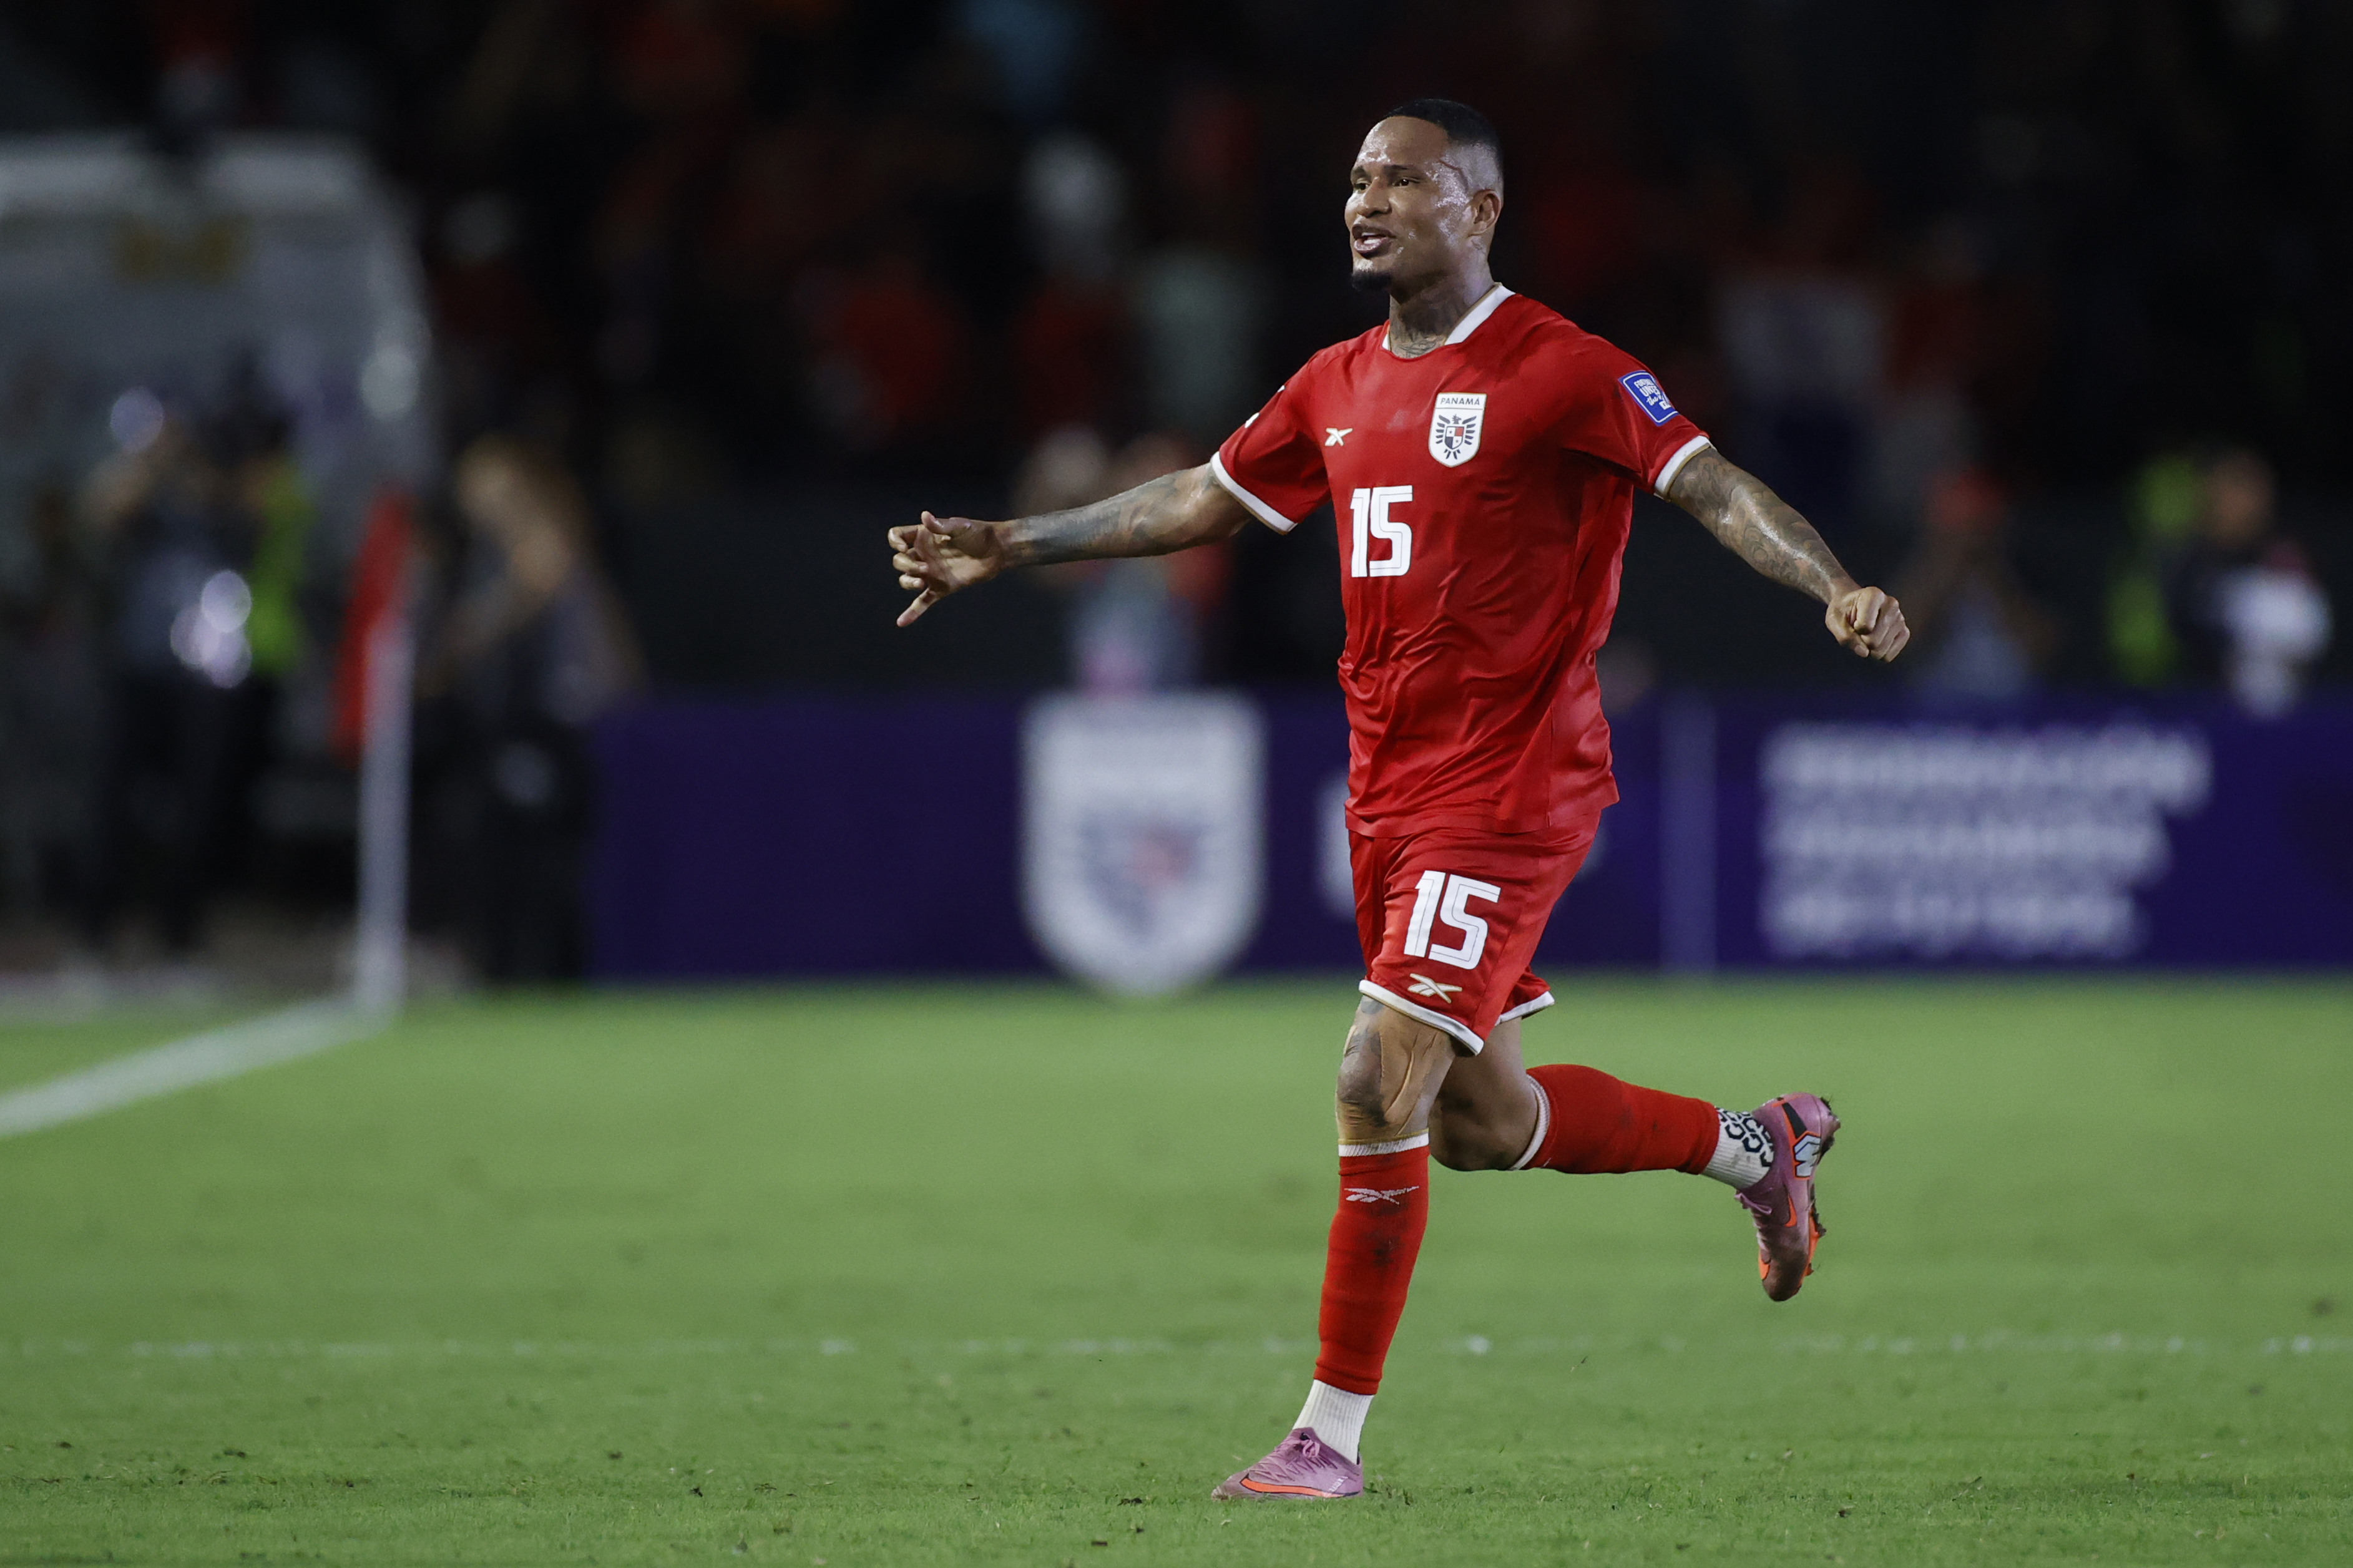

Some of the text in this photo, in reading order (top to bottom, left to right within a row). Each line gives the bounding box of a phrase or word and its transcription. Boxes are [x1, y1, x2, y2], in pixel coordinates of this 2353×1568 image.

[1440, 397, 1480, 406] PANAMÁ
[1349, 485, 1414, 578] 15
[1403, 870, 1502, 970] 15
